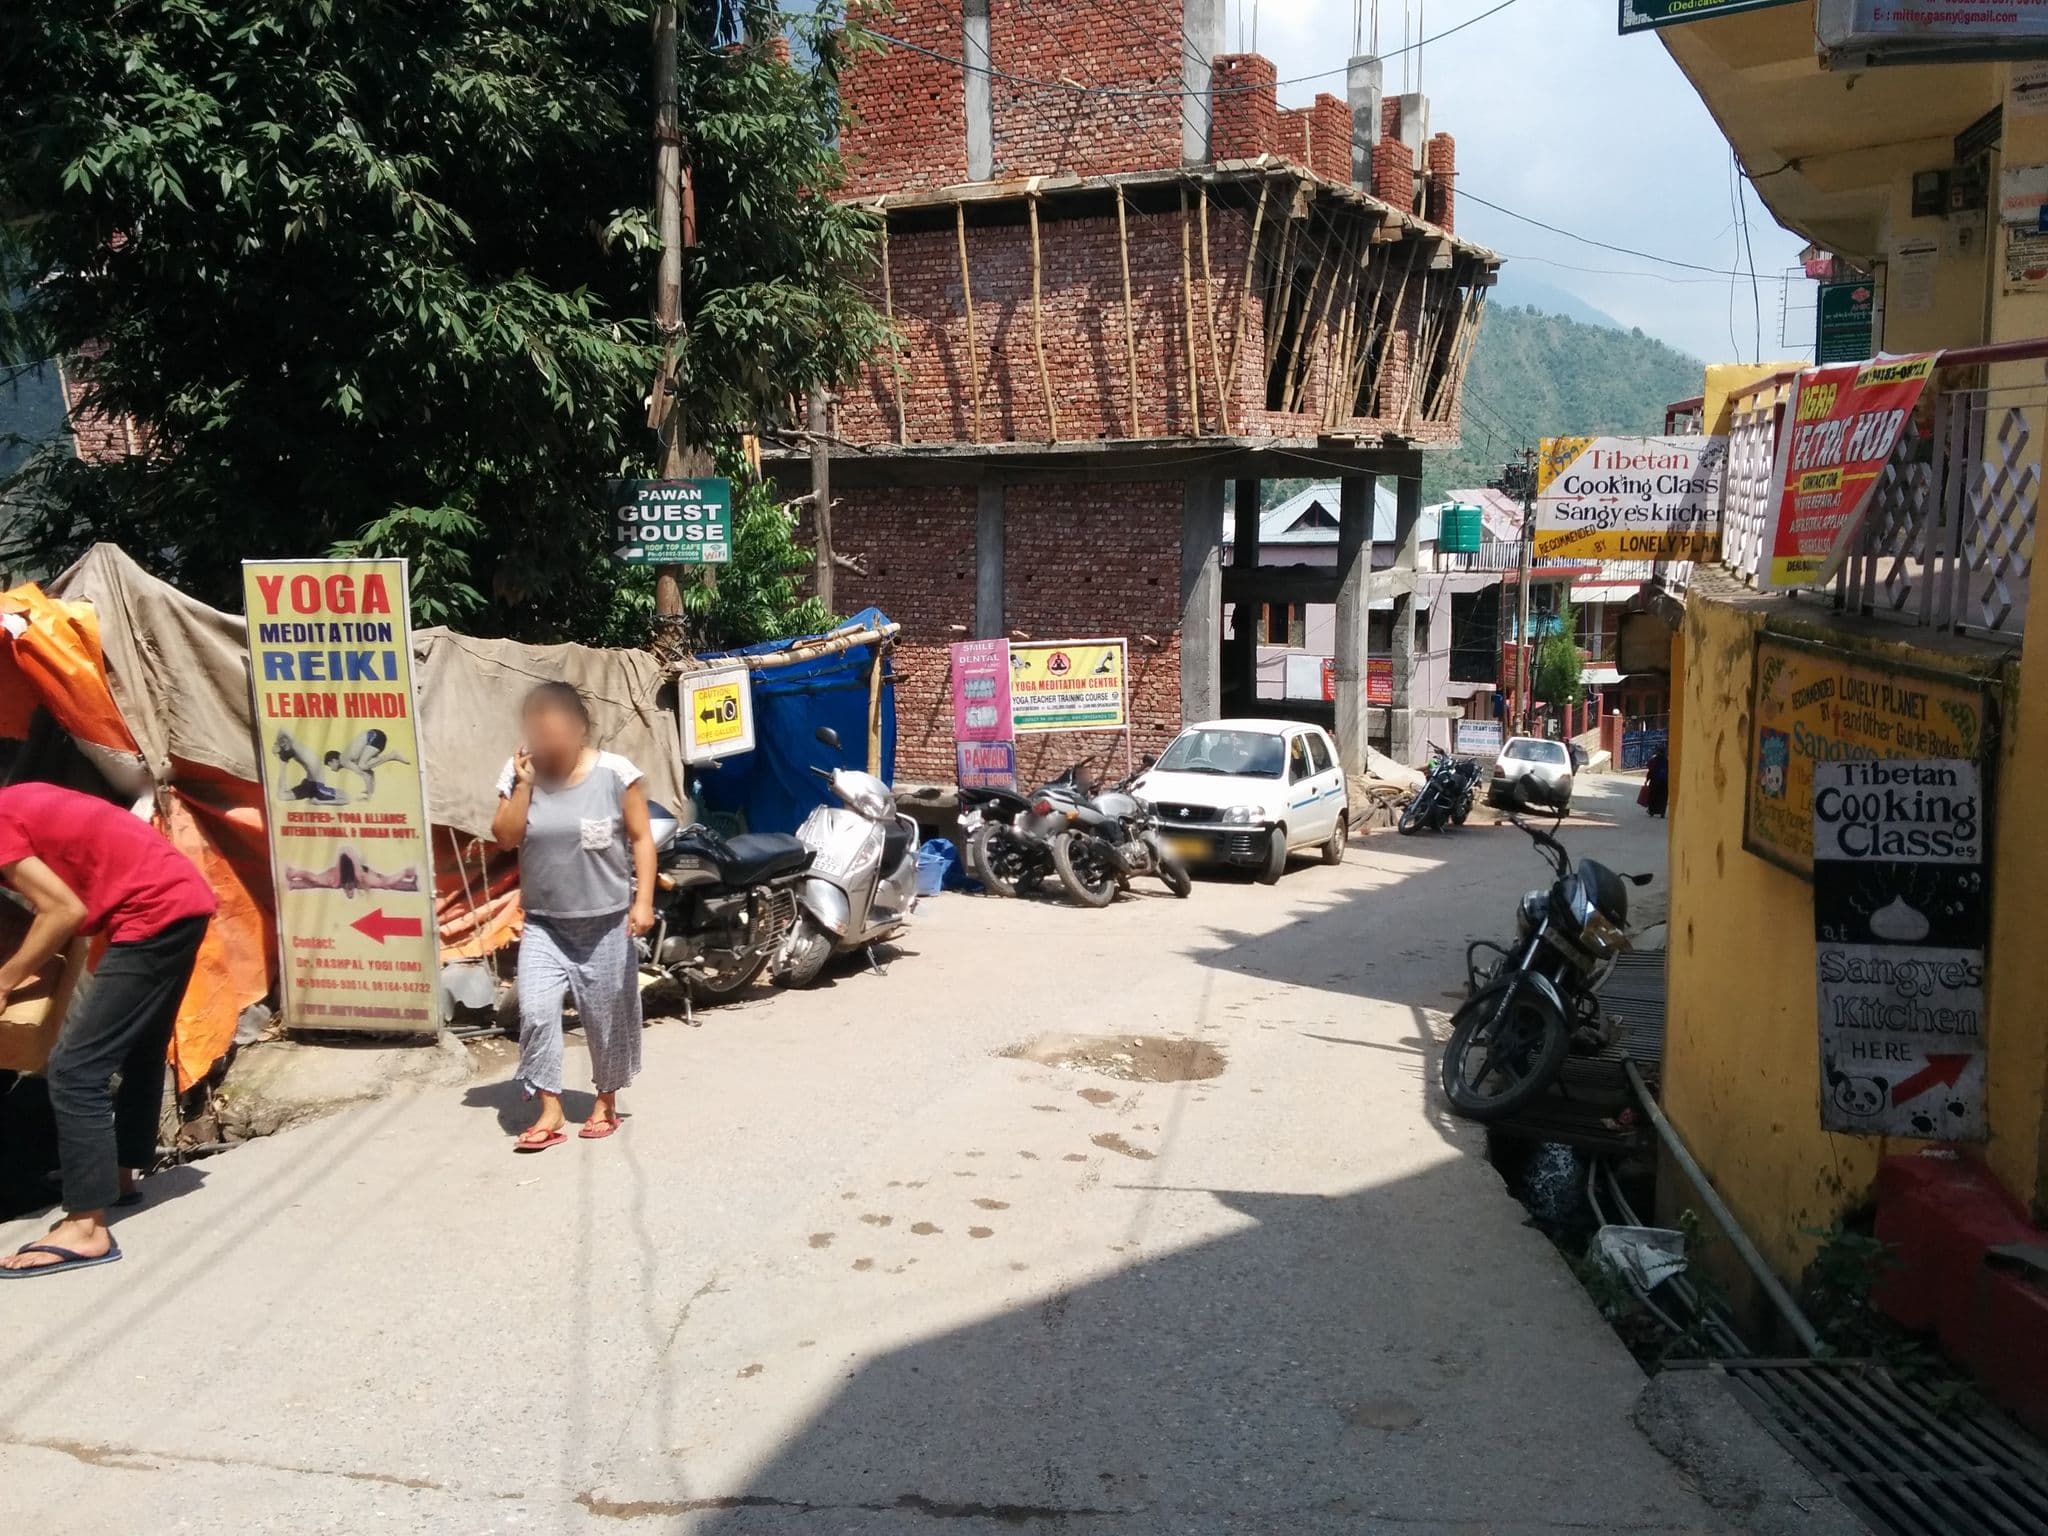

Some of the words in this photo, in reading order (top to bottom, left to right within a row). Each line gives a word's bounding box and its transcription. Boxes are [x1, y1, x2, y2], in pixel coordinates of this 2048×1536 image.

[1846, 408, 1904, 463] HUB
[1587, 450, 1689, 470] Tibetan
[638, 489, 702, 501] PAWAN
[1564, 474, 1652, 501] Cooking
[1657, 475, 1719, 494] Class
[618, 504, 722, 522] GUEST
[1555, 503, 1649, 529] Sangye's
[617, 524, 724, 541] HOUSE
[1538, 524, 1597, 554] RECOMMENDED
[1593, 539, 1607, 553] BY
[1620, 536, 1676, 552] LONELY
[256, 574, 391, 615] YOGA
[259, 622, 393, 643] MEDITATION
[963, 642, 994, 652] SMILE
[263, 651, 398, 681] REIKI
[960, 653, 1000, 664] DENTAL
[1015, 681, 1036, 692] YOGA
[1038, 679, 1086, 691] MEDITATION
[1089, 677, 1118, 689] CENTRE
[265, 692, 338, 718] LEARN
[344, 692, 407, 718] HINDI
[1012, 696, 1029, 705] YOGA
[1030, 694, 1056, 704] TEACHER
[1057, 693, 1084, 703] TRAINING
[1085, 692, 1108, 702] COURSE
[1840, 675, 1878, 709] LONELY
[1882, 685, 1928, 721] PLANET
[964, 747, 1008, 768] PAWAN
[1839, 762, 1958, 786] Tibetan
[1815, 787, 1977, 841] Cooking
[1822, 924, 1848, 941] at
[1820, 951, 1982, 998] Sangye's
[1834, 995, 1978, 1036] Kitchen
[1851, 1041, 1912, 1062] HERE
